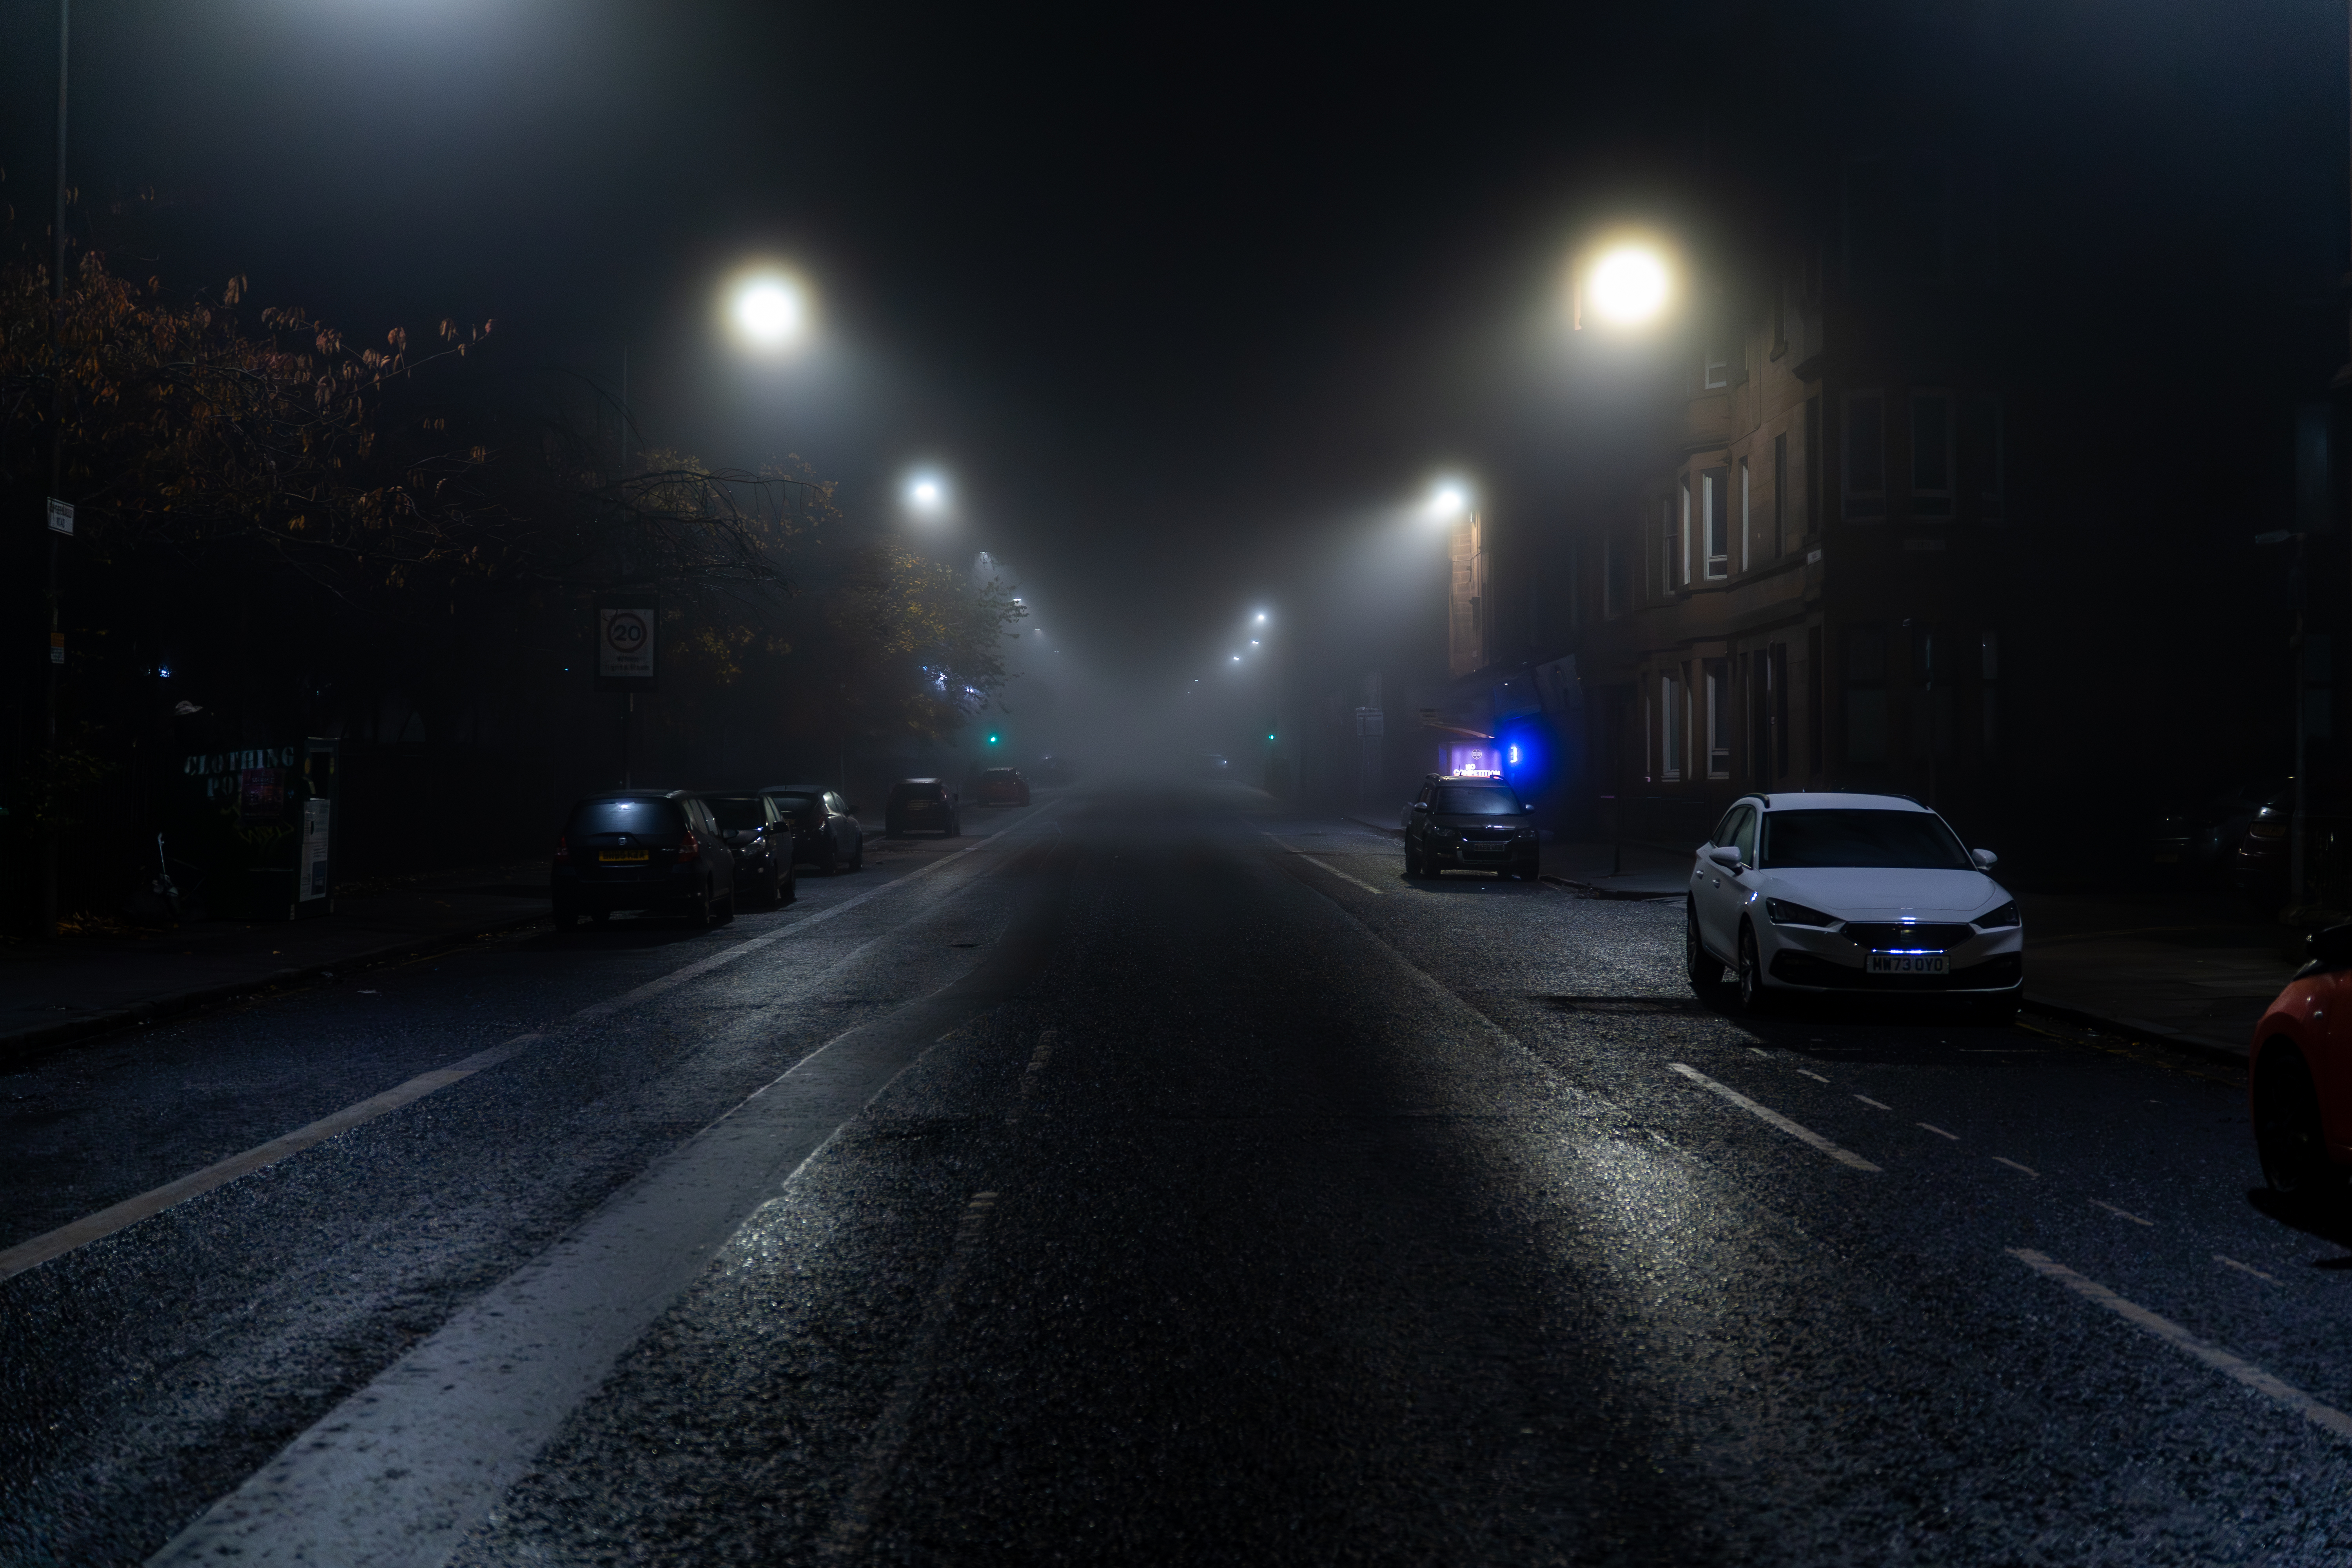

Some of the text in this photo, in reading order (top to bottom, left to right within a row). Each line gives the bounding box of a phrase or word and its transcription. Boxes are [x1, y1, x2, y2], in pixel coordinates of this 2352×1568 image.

[613, 624, 641, 641] 20
[183, 746, 294, 776] CLOTHING
[1873, 957, 1943, 971] MW73 OYO
